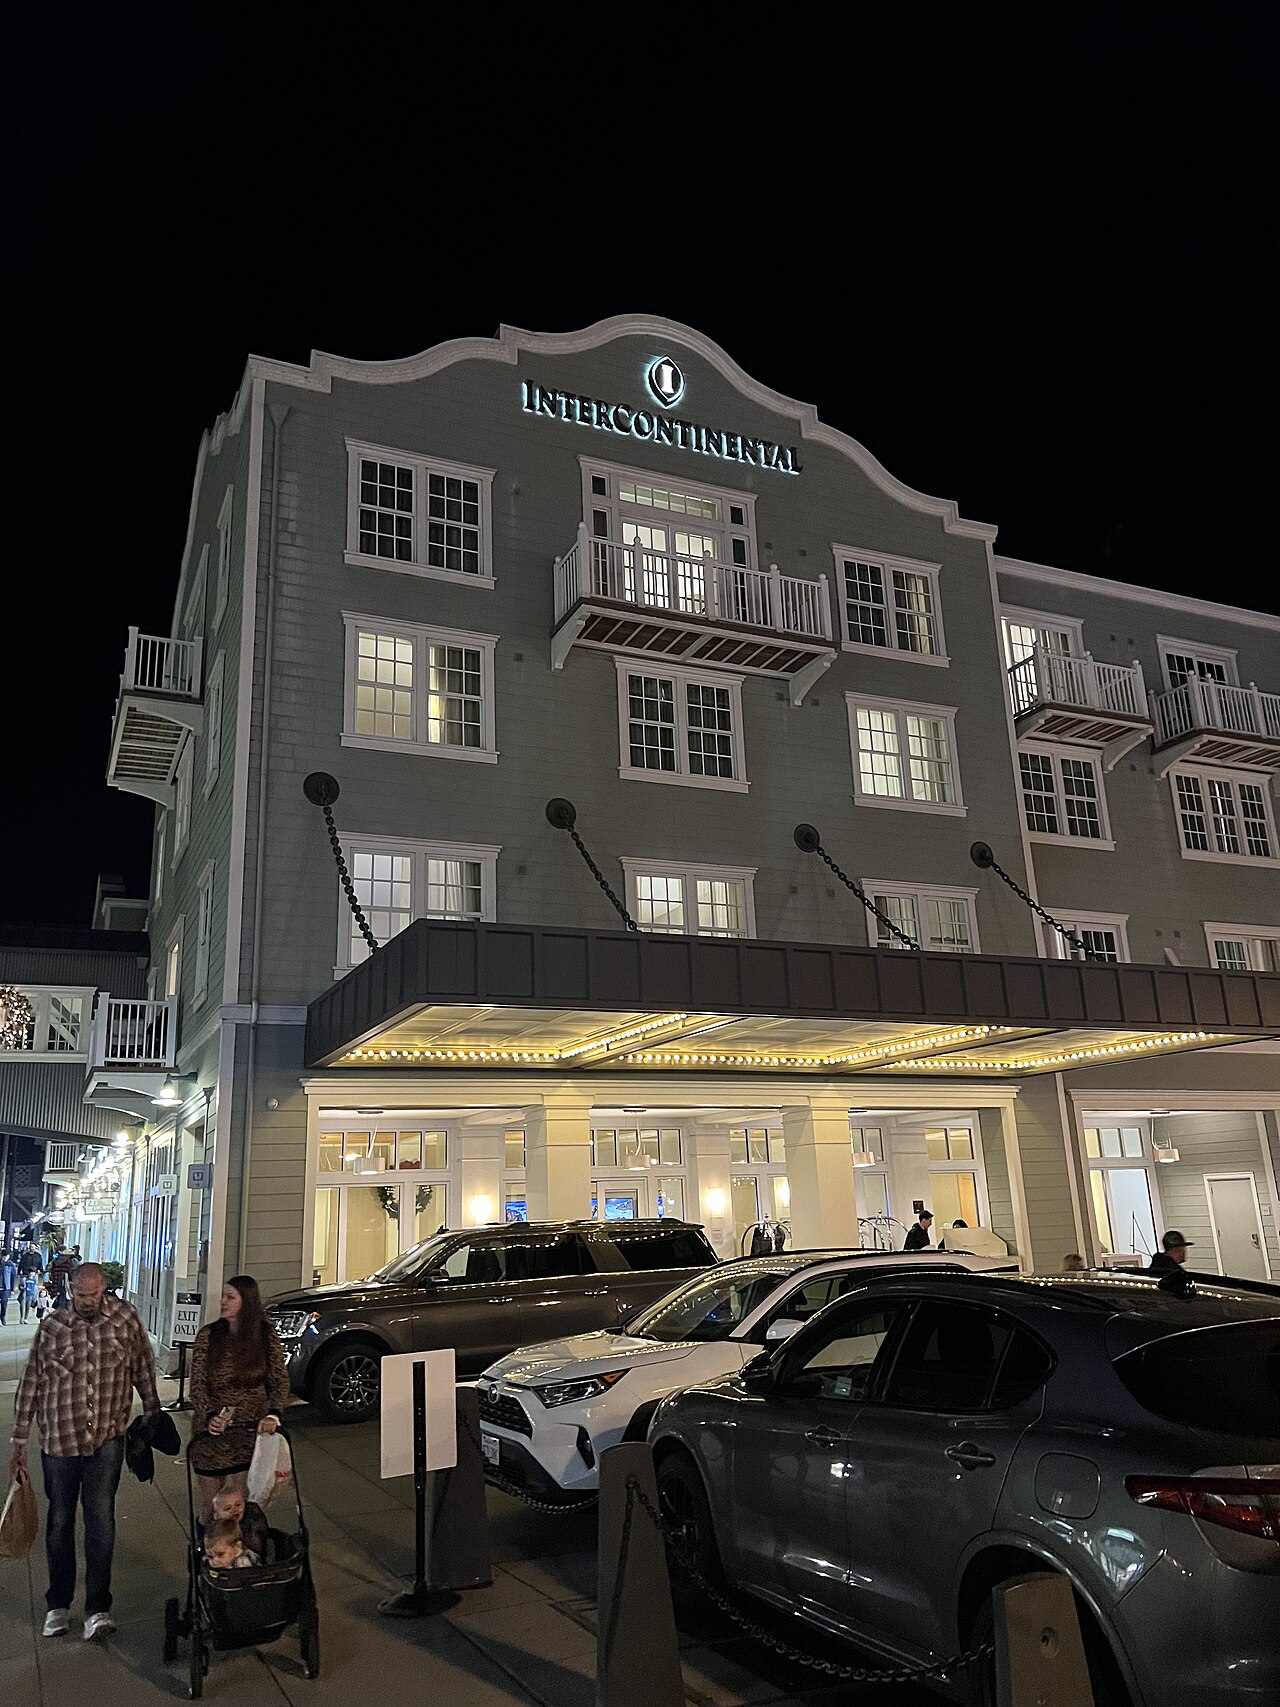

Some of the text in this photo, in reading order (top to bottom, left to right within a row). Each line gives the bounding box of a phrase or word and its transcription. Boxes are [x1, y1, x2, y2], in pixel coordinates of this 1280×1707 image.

[521, 379, 803, 474] INTERCONTINENTAL
[177, 1310, 198, 1322] EXIT
[174, 1323, 198, 1336] ONLY
